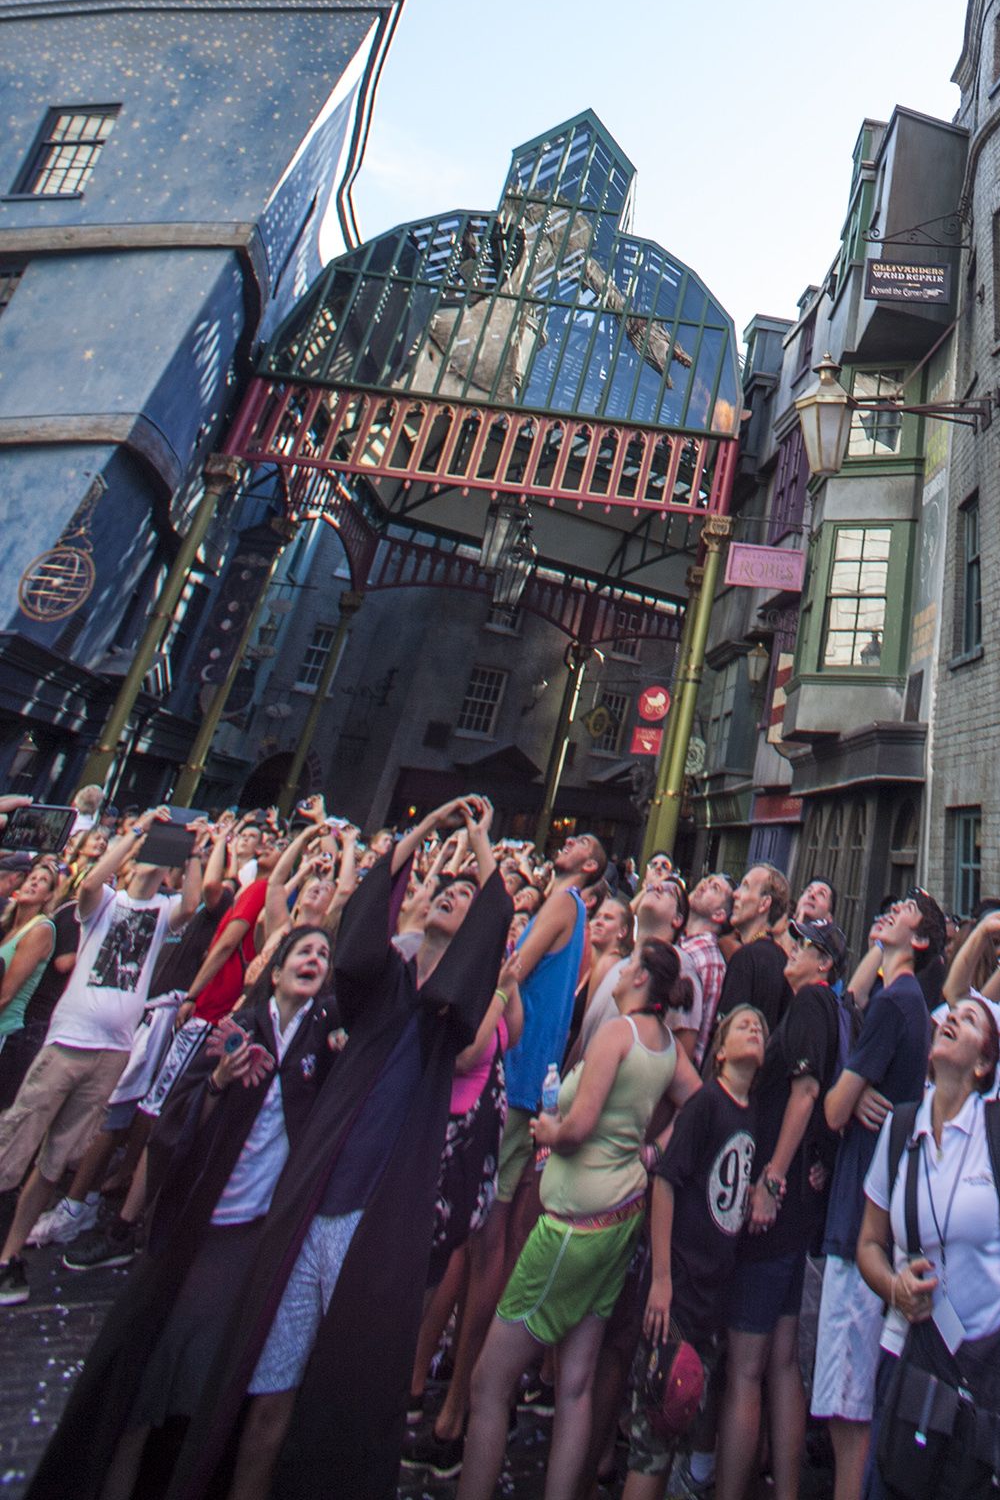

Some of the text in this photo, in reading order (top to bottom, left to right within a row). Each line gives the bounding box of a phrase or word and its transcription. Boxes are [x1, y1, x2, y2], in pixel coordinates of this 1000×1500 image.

[872, 263, 944, 275] OLLIVANDERS
[872, 271, 944, 283] WAND REPAIR
[739, 560, 794, 582] ROBES
